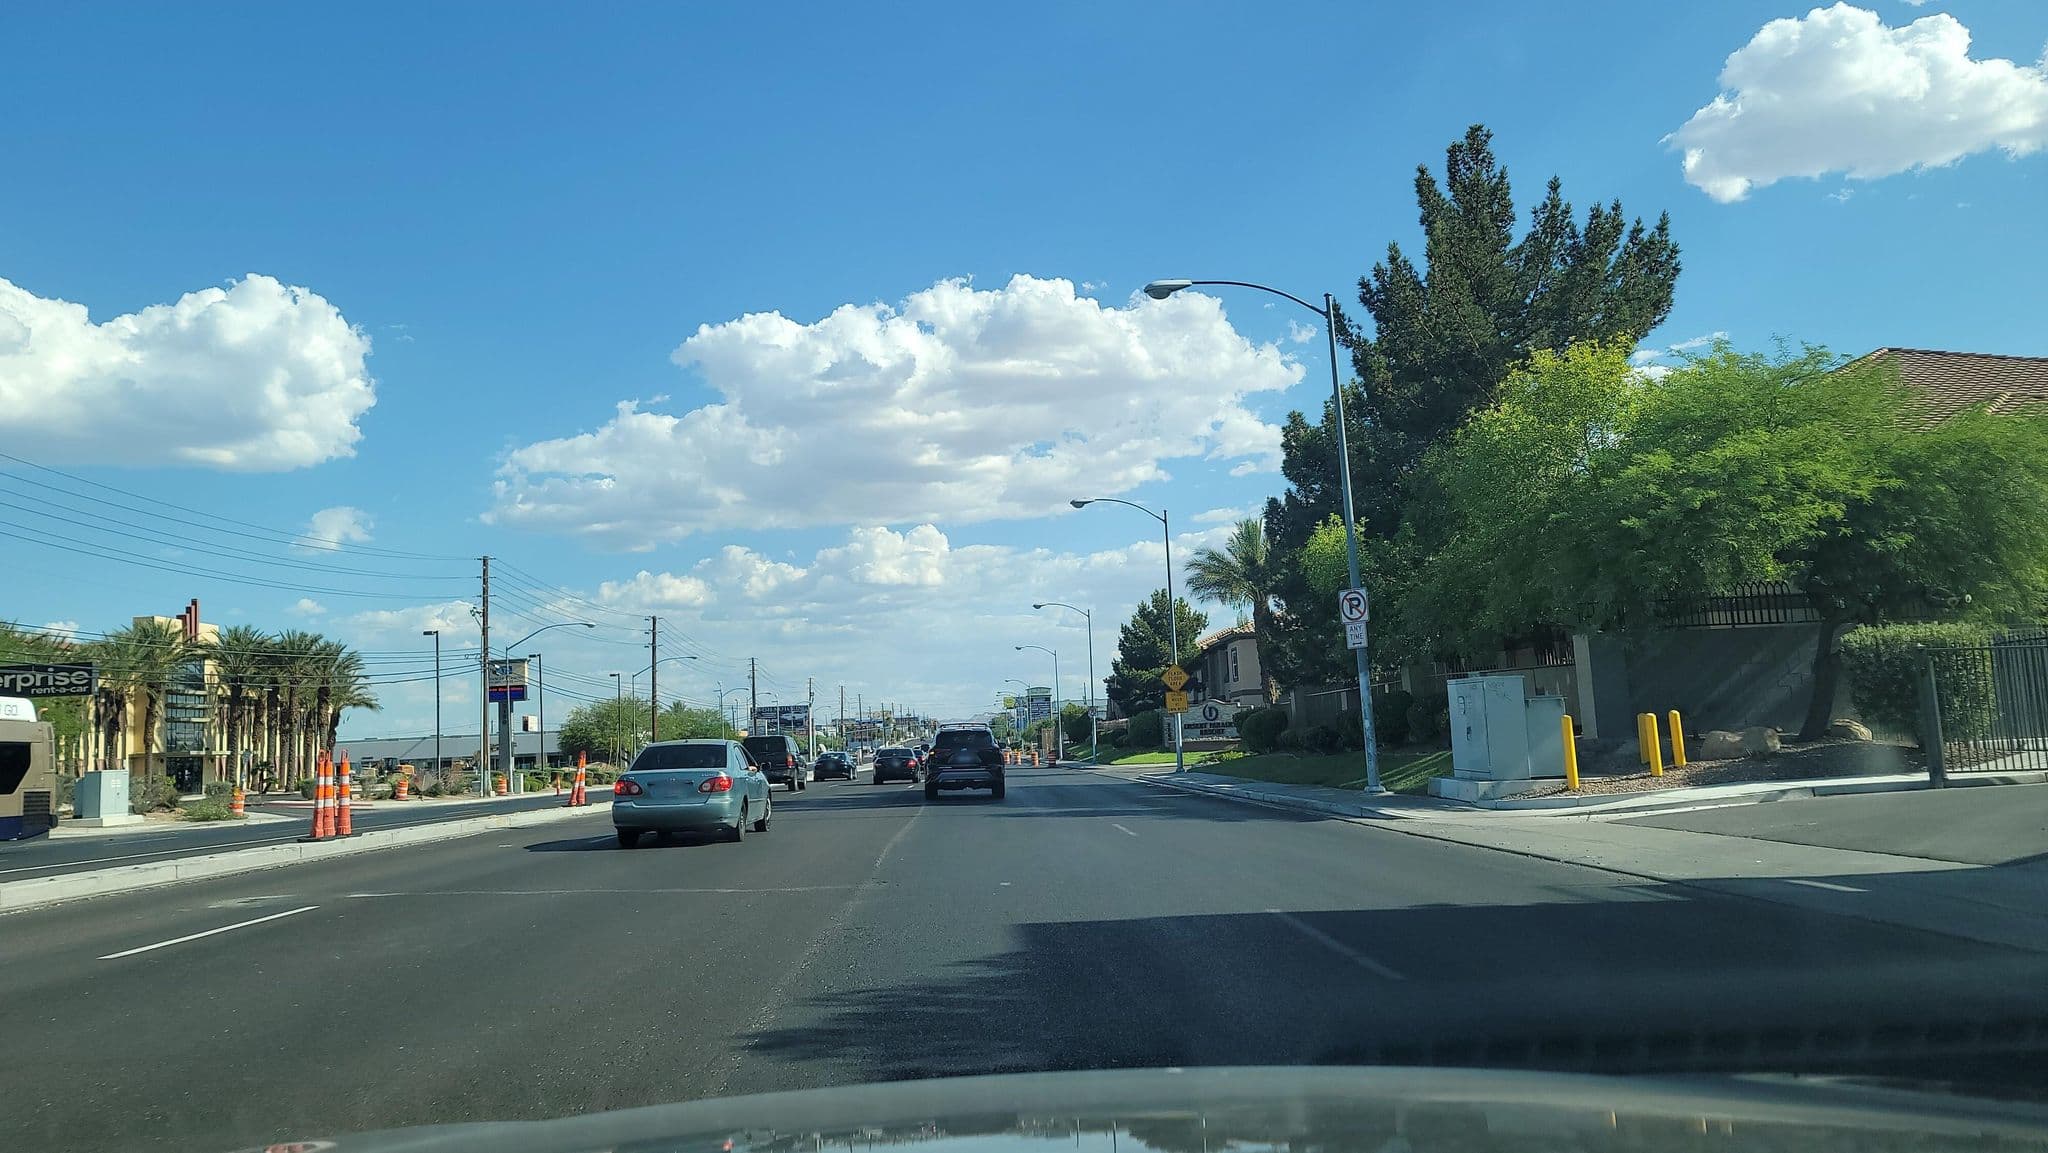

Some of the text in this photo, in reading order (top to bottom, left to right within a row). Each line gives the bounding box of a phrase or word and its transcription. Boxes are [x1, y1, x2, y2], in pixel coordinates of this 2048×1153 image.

[1350, 624, 1363, 632] ANY
[1349, 632, 1364, 640] TIME
[0, 667, 90, 693] rprise
[31, 685, 89, 694] rent-a-car
